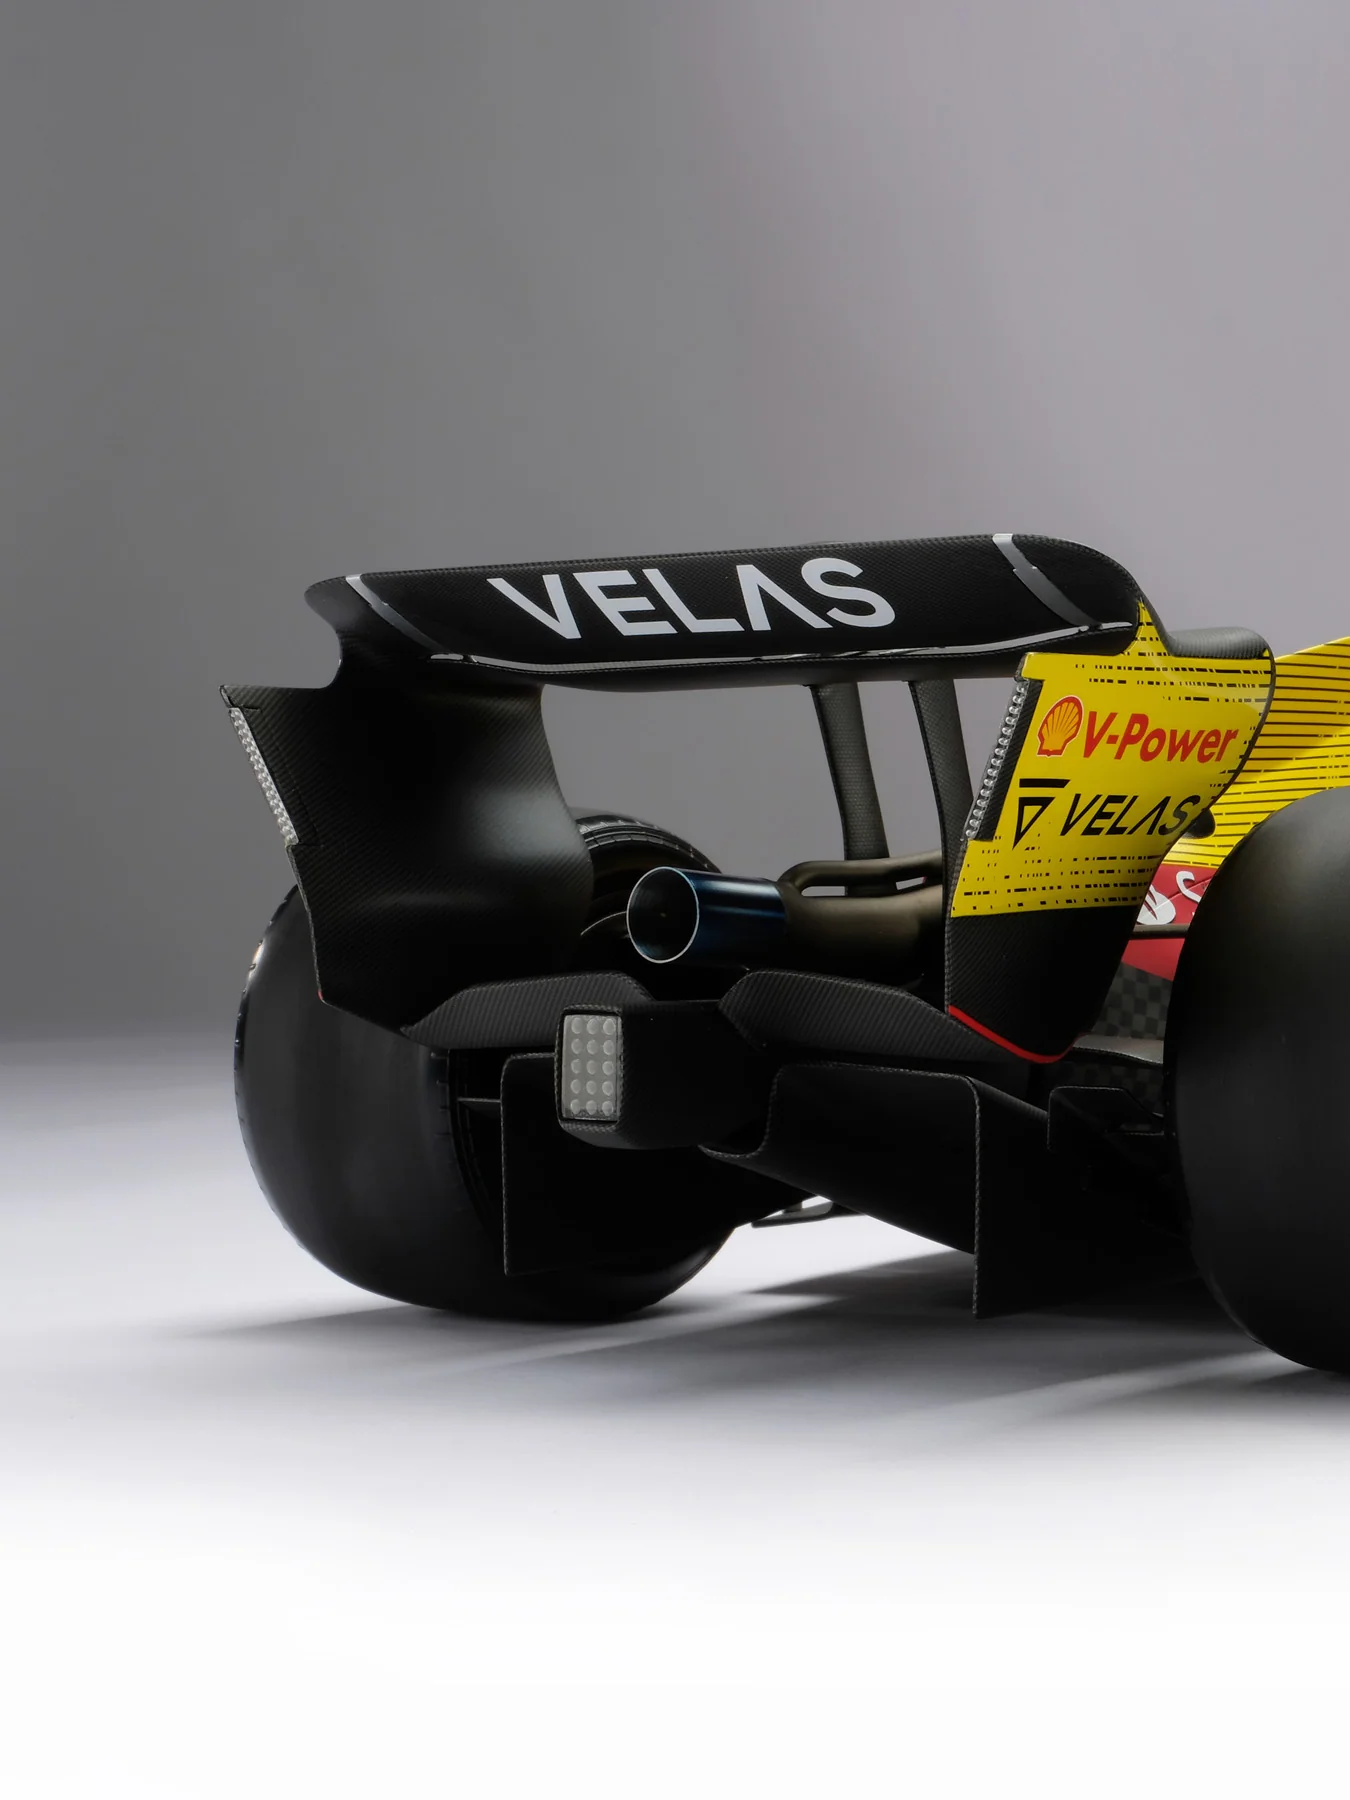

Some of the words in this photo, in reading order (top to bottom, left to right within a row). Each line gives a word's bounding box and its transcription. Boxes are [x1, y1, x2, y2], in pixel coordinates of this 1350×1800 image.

[488, 557, 896, 639] VELAS
[1084, 710, 1240, 764] V-Power
[1060, 792, 1201, 836] VELAS
